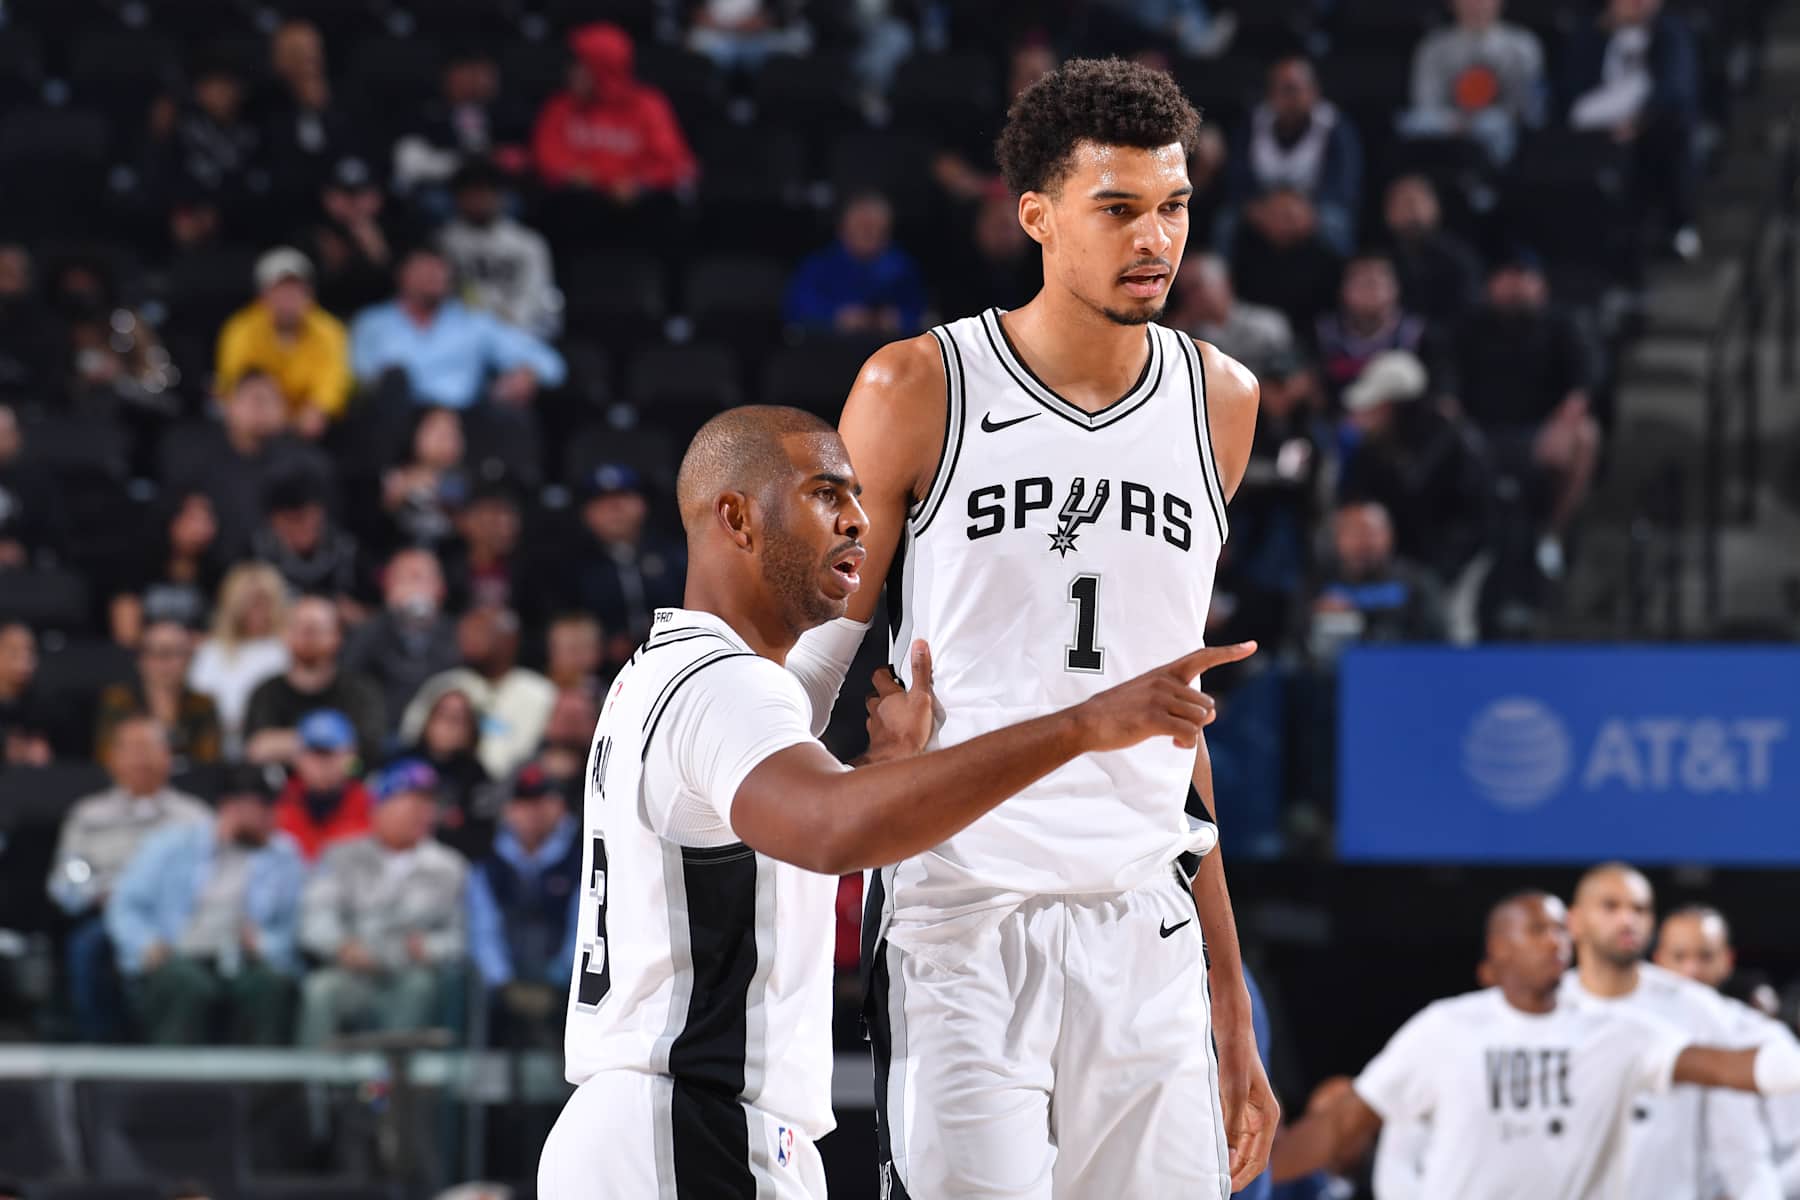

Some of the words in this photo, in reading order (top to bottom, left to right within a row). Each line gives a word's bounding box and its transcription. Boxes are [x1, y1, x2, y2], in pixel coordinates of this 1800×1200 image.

[967, 476, 1192, 559] SPURS
[1065, 573, 1105, 675] 1
[1583, 717, 1787, 792] AT&T
[576, 829, 612, 1015] 3
[1485, 1047, 1572, 1111] VOTE
